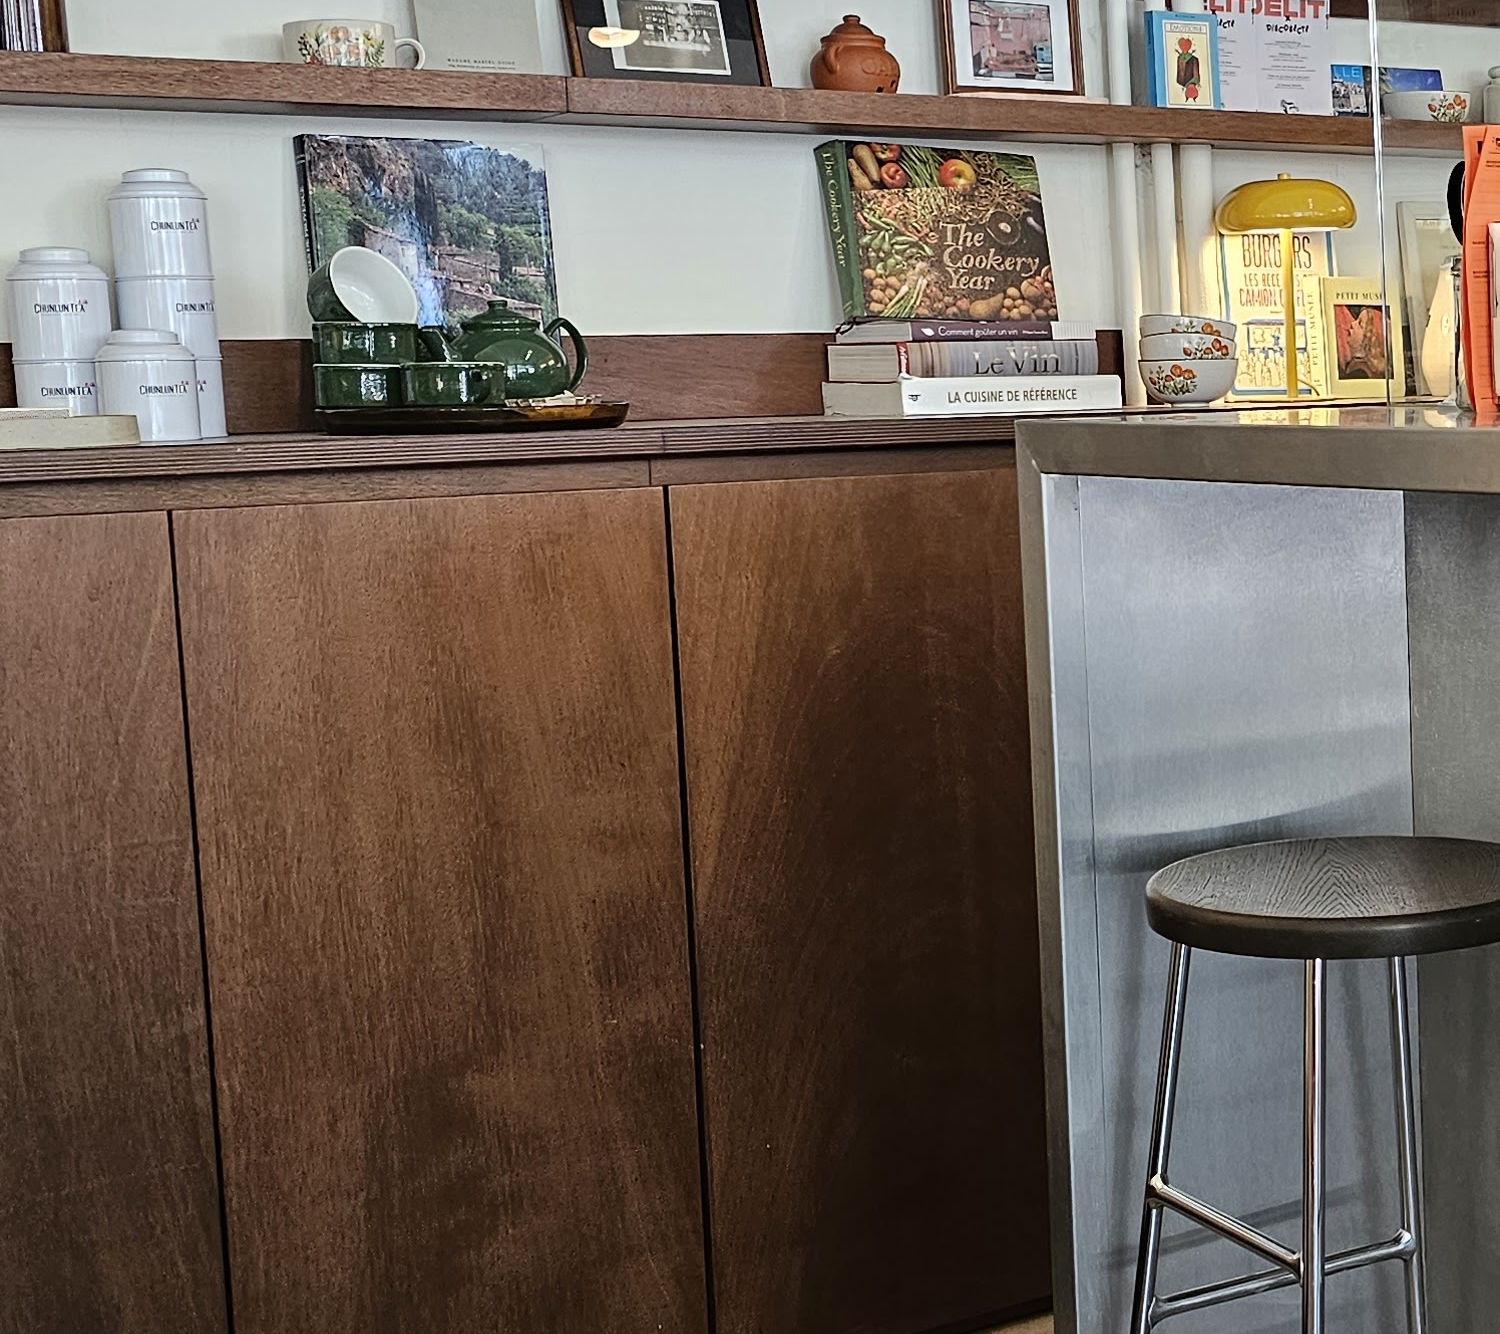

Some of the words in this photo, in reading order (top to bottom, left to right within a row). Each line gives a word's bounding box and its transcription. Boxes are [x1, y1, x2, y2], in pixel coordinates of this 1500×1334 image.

[822, 151, 833, 177] The
[827, 177, 842, 233] Cookery
[939, 222, 984, 247] The
[834, 233, 846, 267] Year
[942, 246, 1039, 277] Cookery
[1242, 235, 1312, 268] BURGRS
[946, 268, 995, 290] Year
[1245, 273, 1258, 287] LES
[1262, 273, 1300, 287] RECES
[1240, 289, 1276, 307] CAMION
[1336, 292, 1358, 300] PETIT
[938, 326, 974, 336] Comment
[975, 327, 998, 339] goûter
[1008, 327, 1018, 335] vin
[972, 351, 1004, 375] Le
[1007, 345, 1062, 374] Vin
[947, 391, 961, 403] LA
[964, 390, 1002, 403] CUISINE
[1007, 390, 1020, 402] DE
[1023, 387, 1077, 401] RÉFÉRENCE
